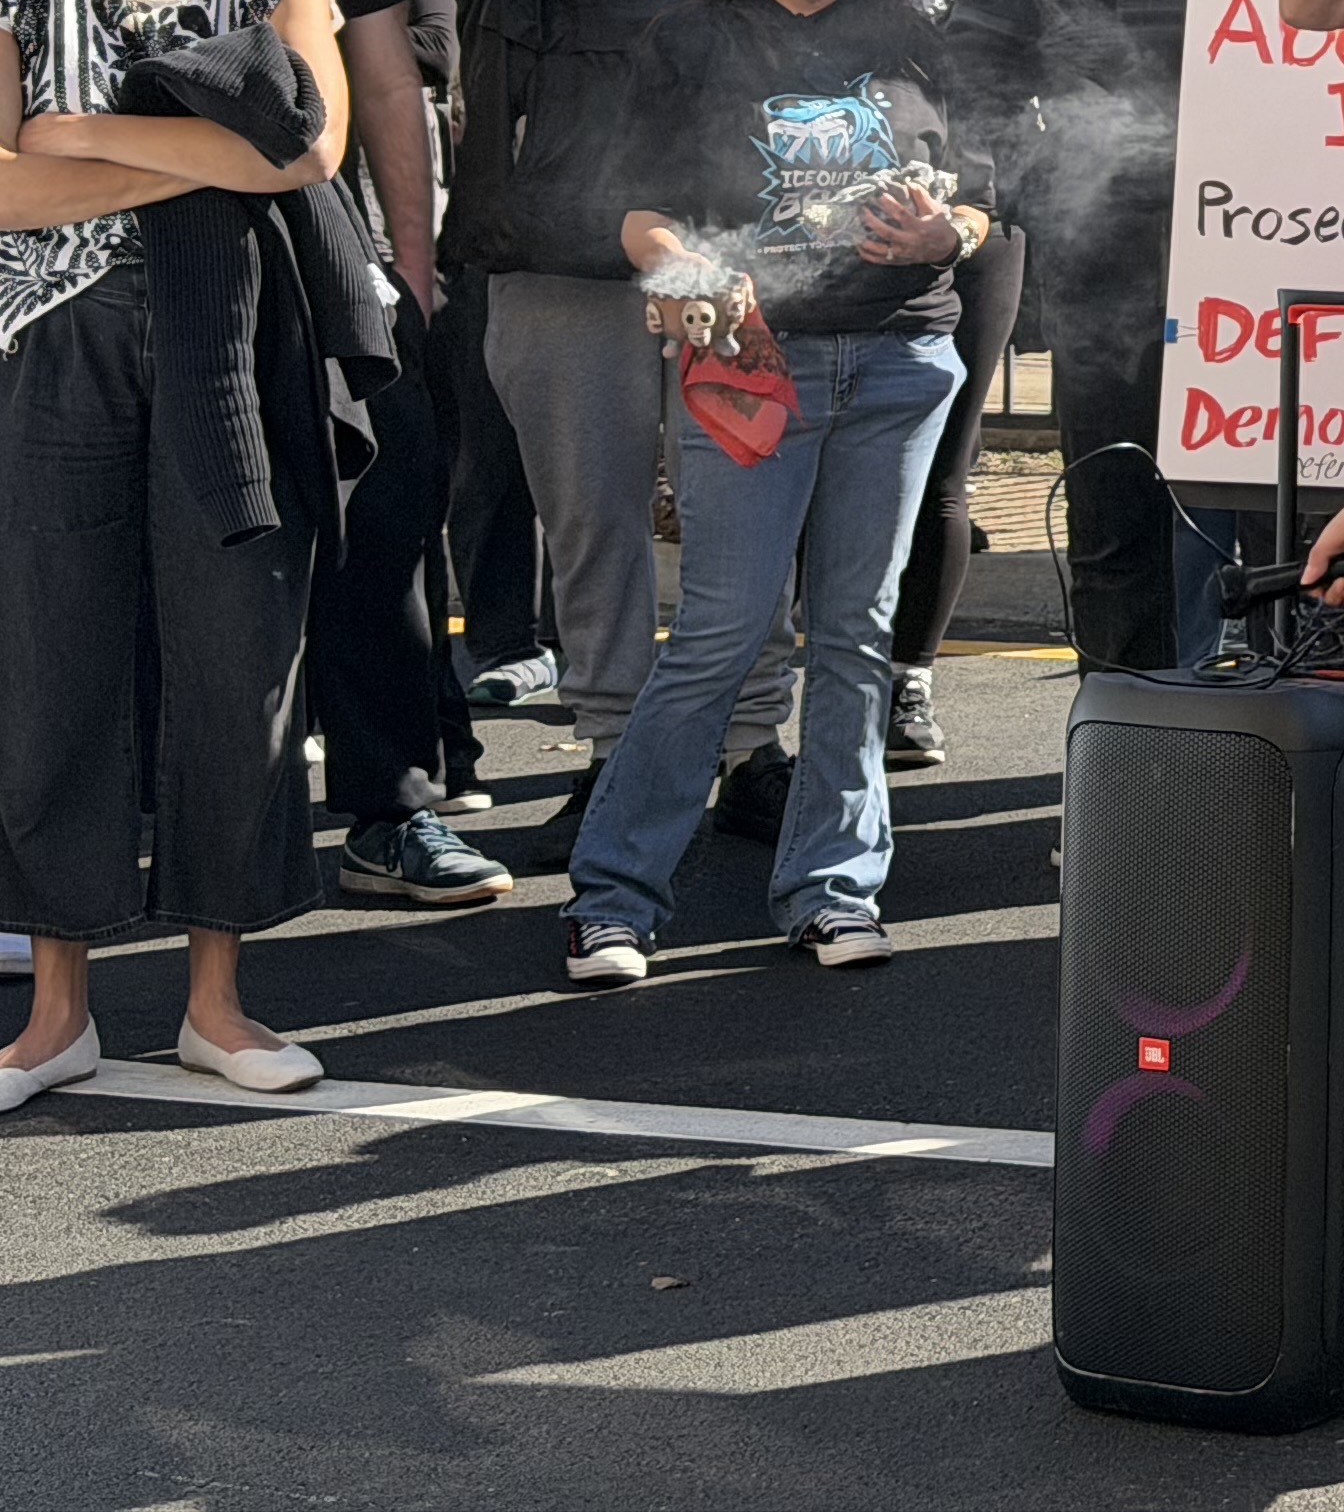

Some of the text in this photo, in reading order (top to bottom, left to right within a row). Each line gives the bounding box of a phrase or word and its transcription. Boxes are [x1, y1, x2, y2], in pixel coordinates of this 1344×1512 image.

[780, 169, 817, 188] ICE
[817, 170, 852, 187] OUT
[1144, 1046, 1165, 1064] JBL
